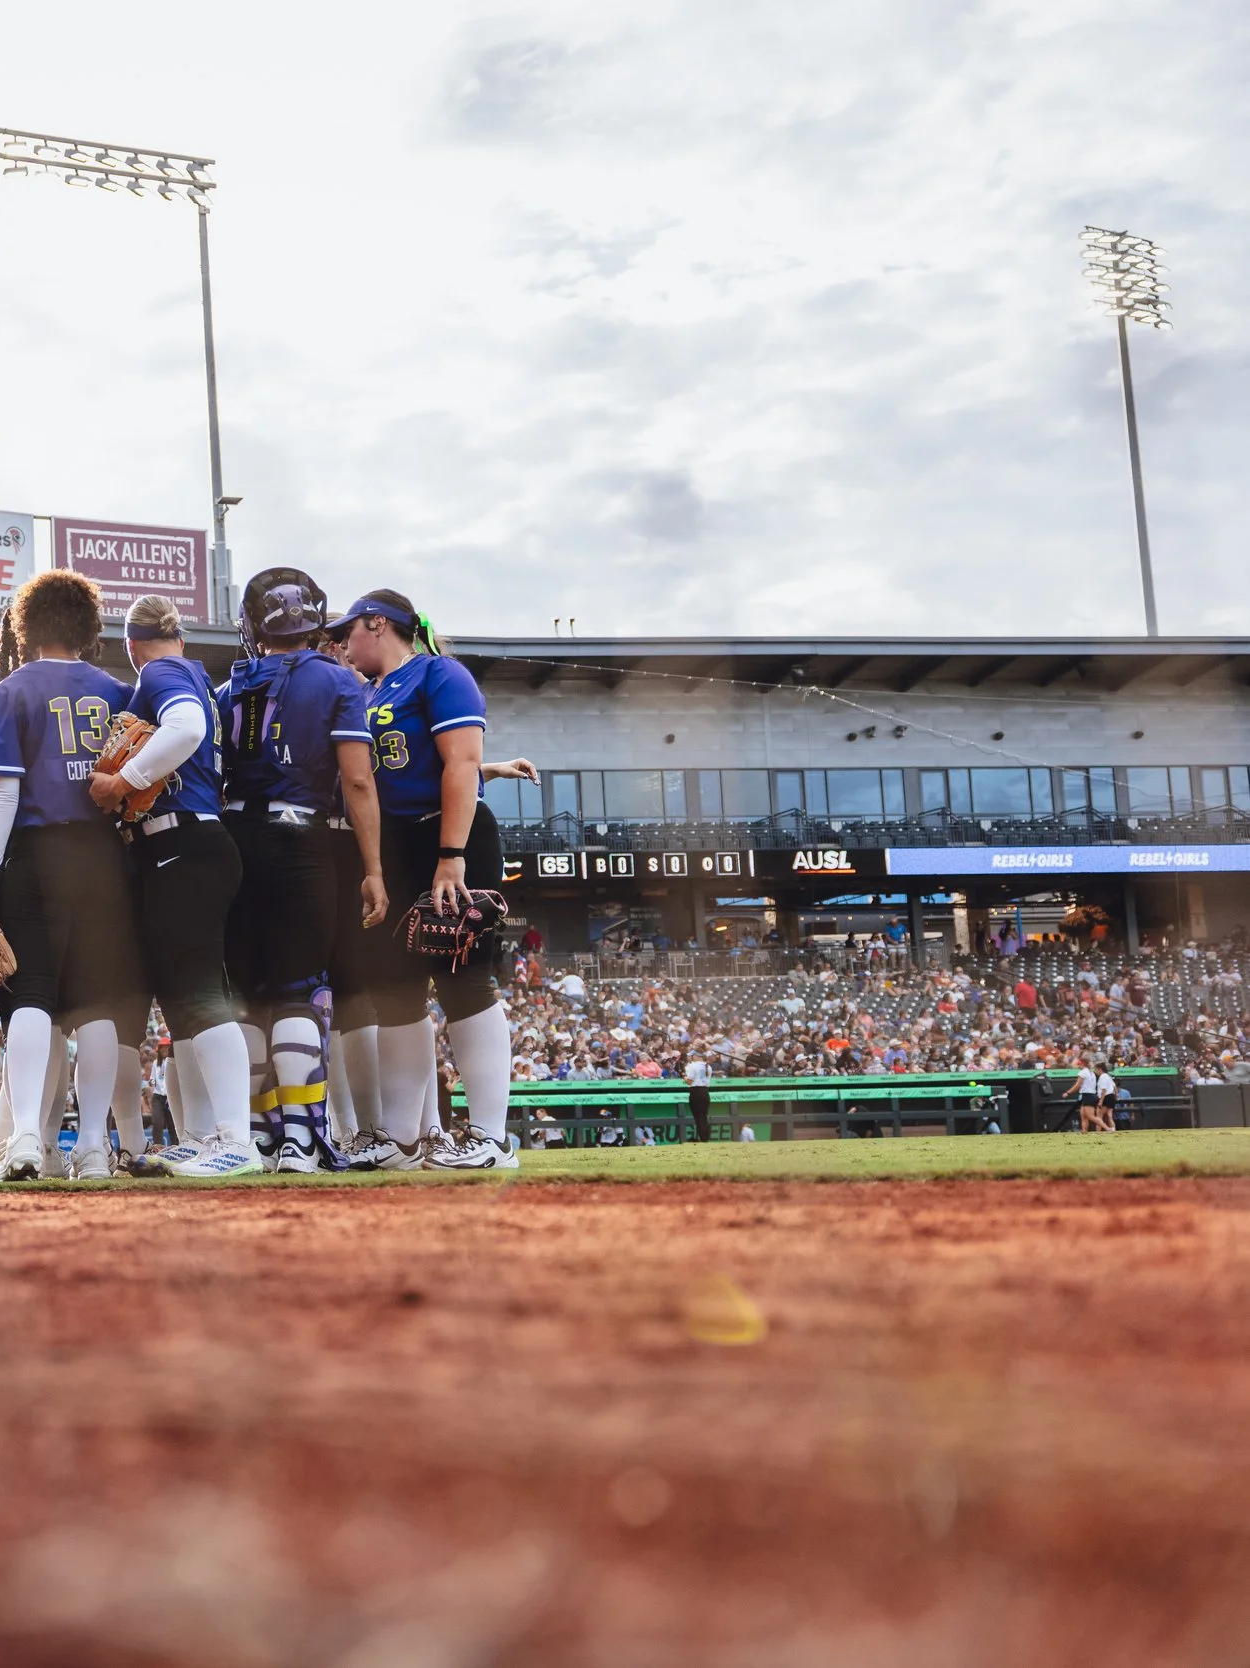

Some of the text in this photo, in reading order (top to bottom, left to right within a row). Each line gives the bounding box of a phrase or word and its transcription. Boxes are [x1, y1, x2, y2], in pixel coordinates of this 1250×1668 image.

[75, 537, 187, 567] JACK ALLEN'S
[121, 567, 186, 582] KITCHEN
[49, 696, 112, 755] 13
[542, 856, 569, 874] 65
[595, 858, 606, 873] B
[617, 857, 627, 873] 0
[648, 857, 658, 872] S
[670, 856, 680, 873] 0
[723, 855, 733, 872] 0
[792, 850, 851, 870] AUSL
[992, 854, 1074, 867] REBEL GIRLS
[1130, 852, 1209, 866] REBEL GIRLS
